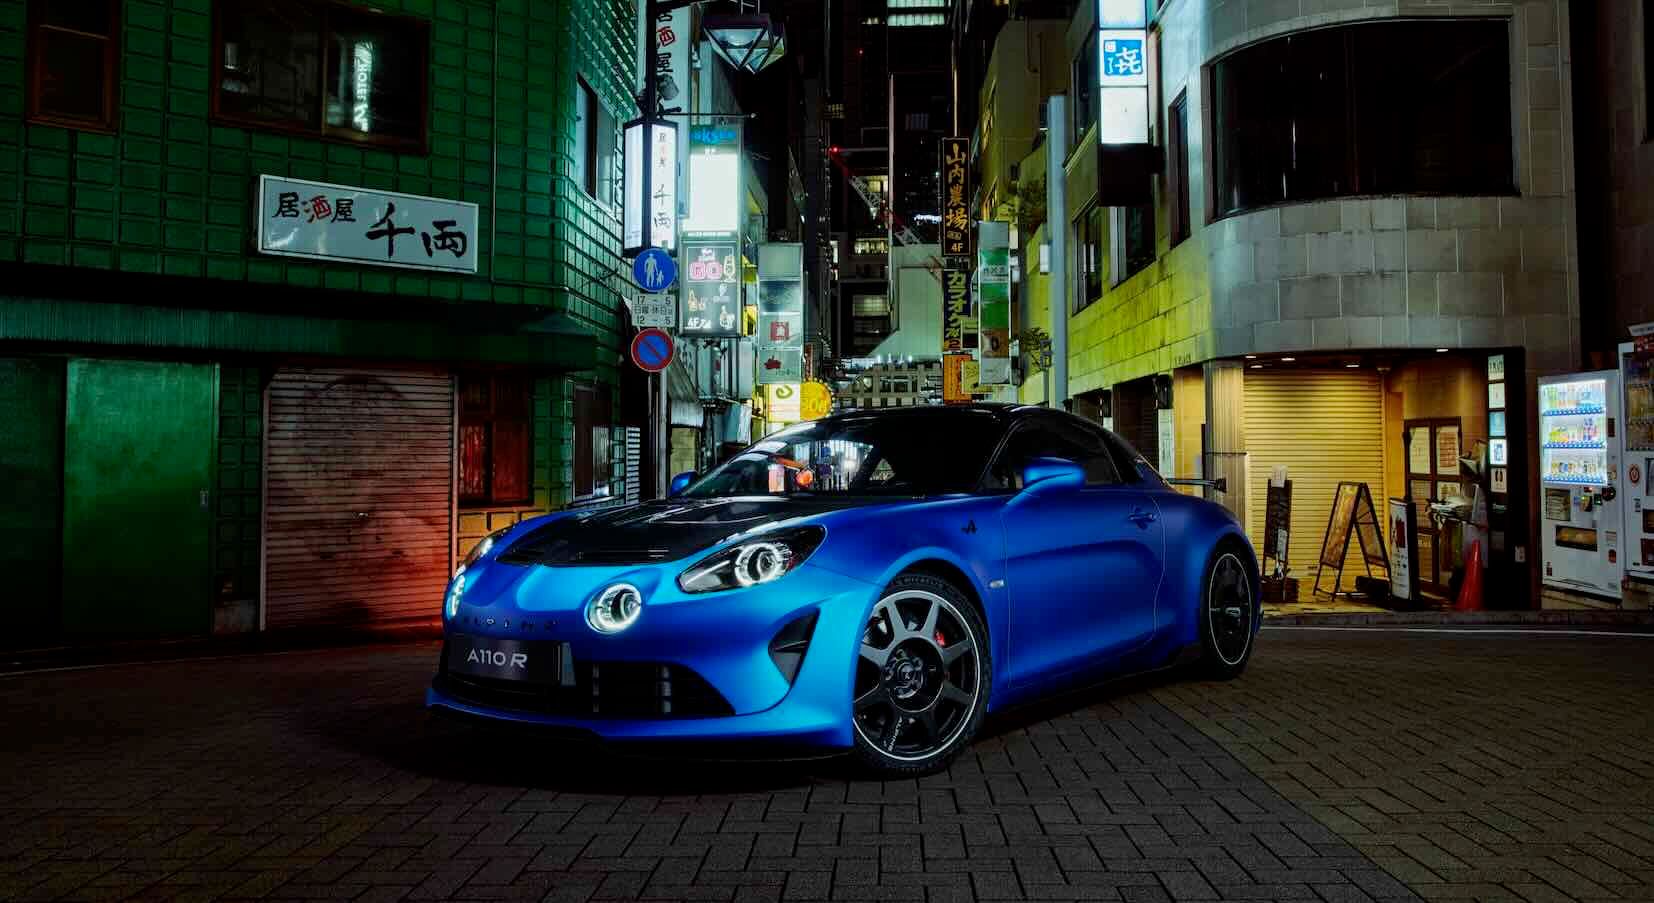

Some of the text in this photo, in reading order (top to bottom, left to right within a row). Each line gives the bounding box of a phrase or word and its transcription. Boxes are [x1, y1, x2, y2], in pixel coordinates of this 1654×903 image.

[946, 143, 968, 232] 山内農場
[272, 192, 468, 258] 居酒屋 千両
[637, 295, 646, 304] 17
[665, 296, 671, 305] 5
[636, 315, 645, 324] 12
[665, 316, 671, 325] 5
[467, 648, 528, 668] A110 R
